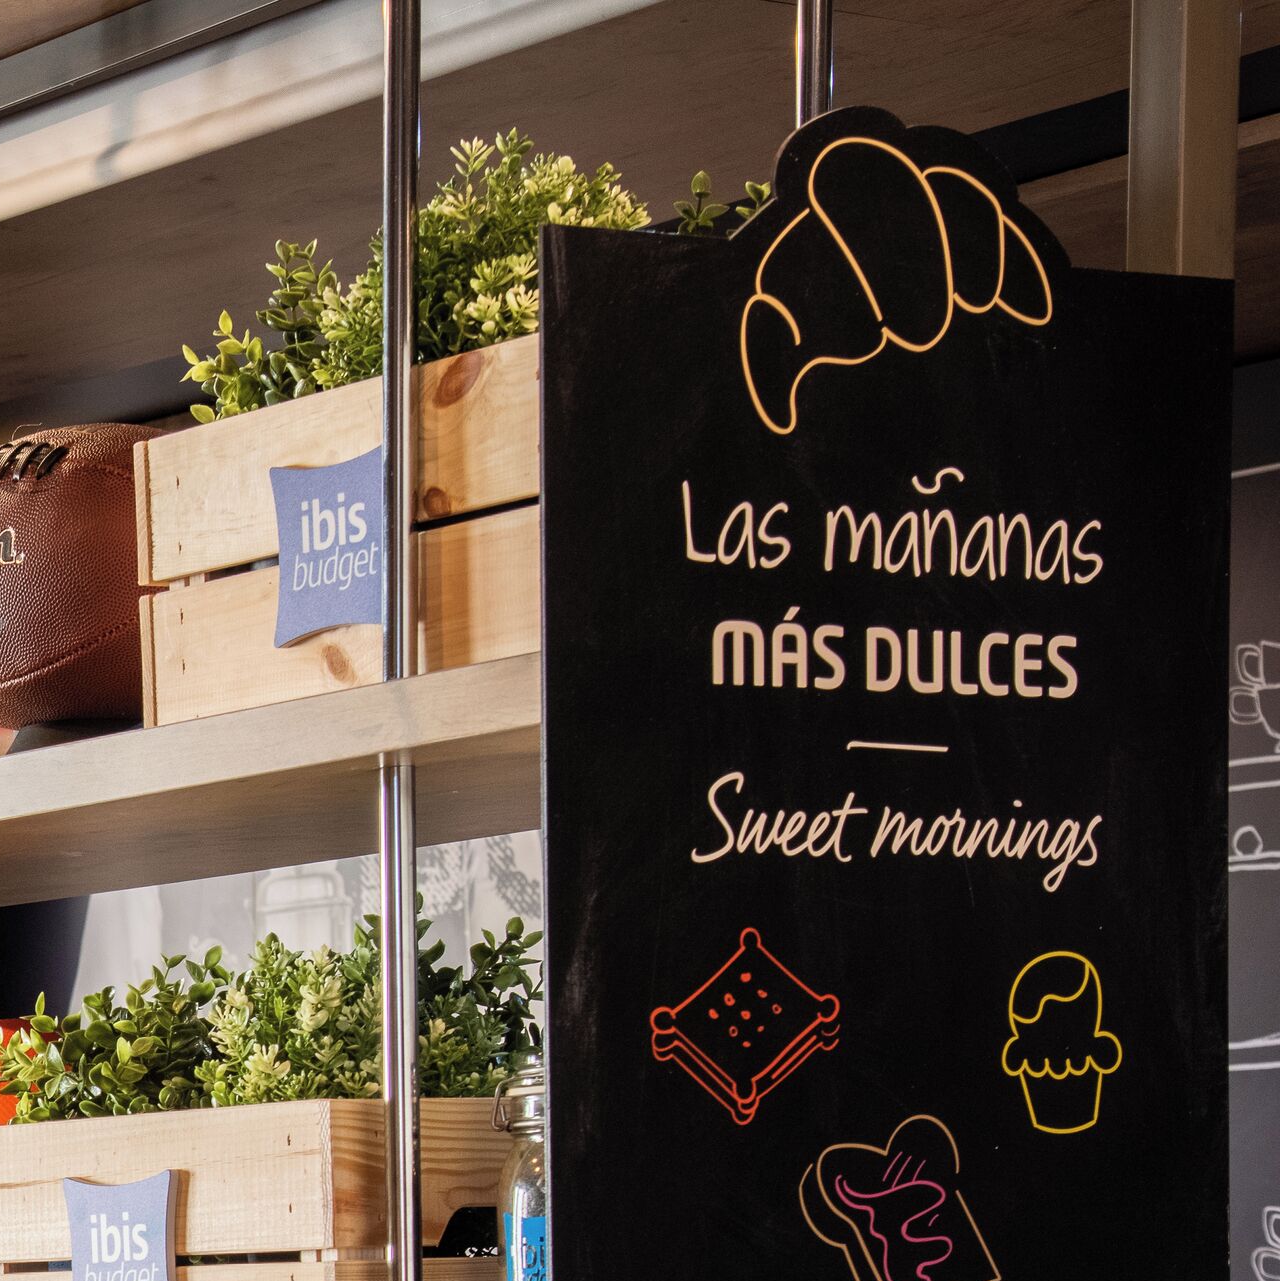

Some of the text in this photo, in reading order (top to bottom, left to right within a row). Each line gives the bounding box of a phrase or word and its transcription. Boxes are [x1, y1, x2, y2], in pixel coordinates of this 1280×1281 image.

[301, 492, 367, 553] ibis
[681, 467, 1104, 585] Las mañanas
[293, 541, 379, 591] budget
[711, 607, 1079, 699] MÁS DULCES
[690, 771, 1103, 893] Sweet mornings
[90, 1211, 149, 1264] ibis
